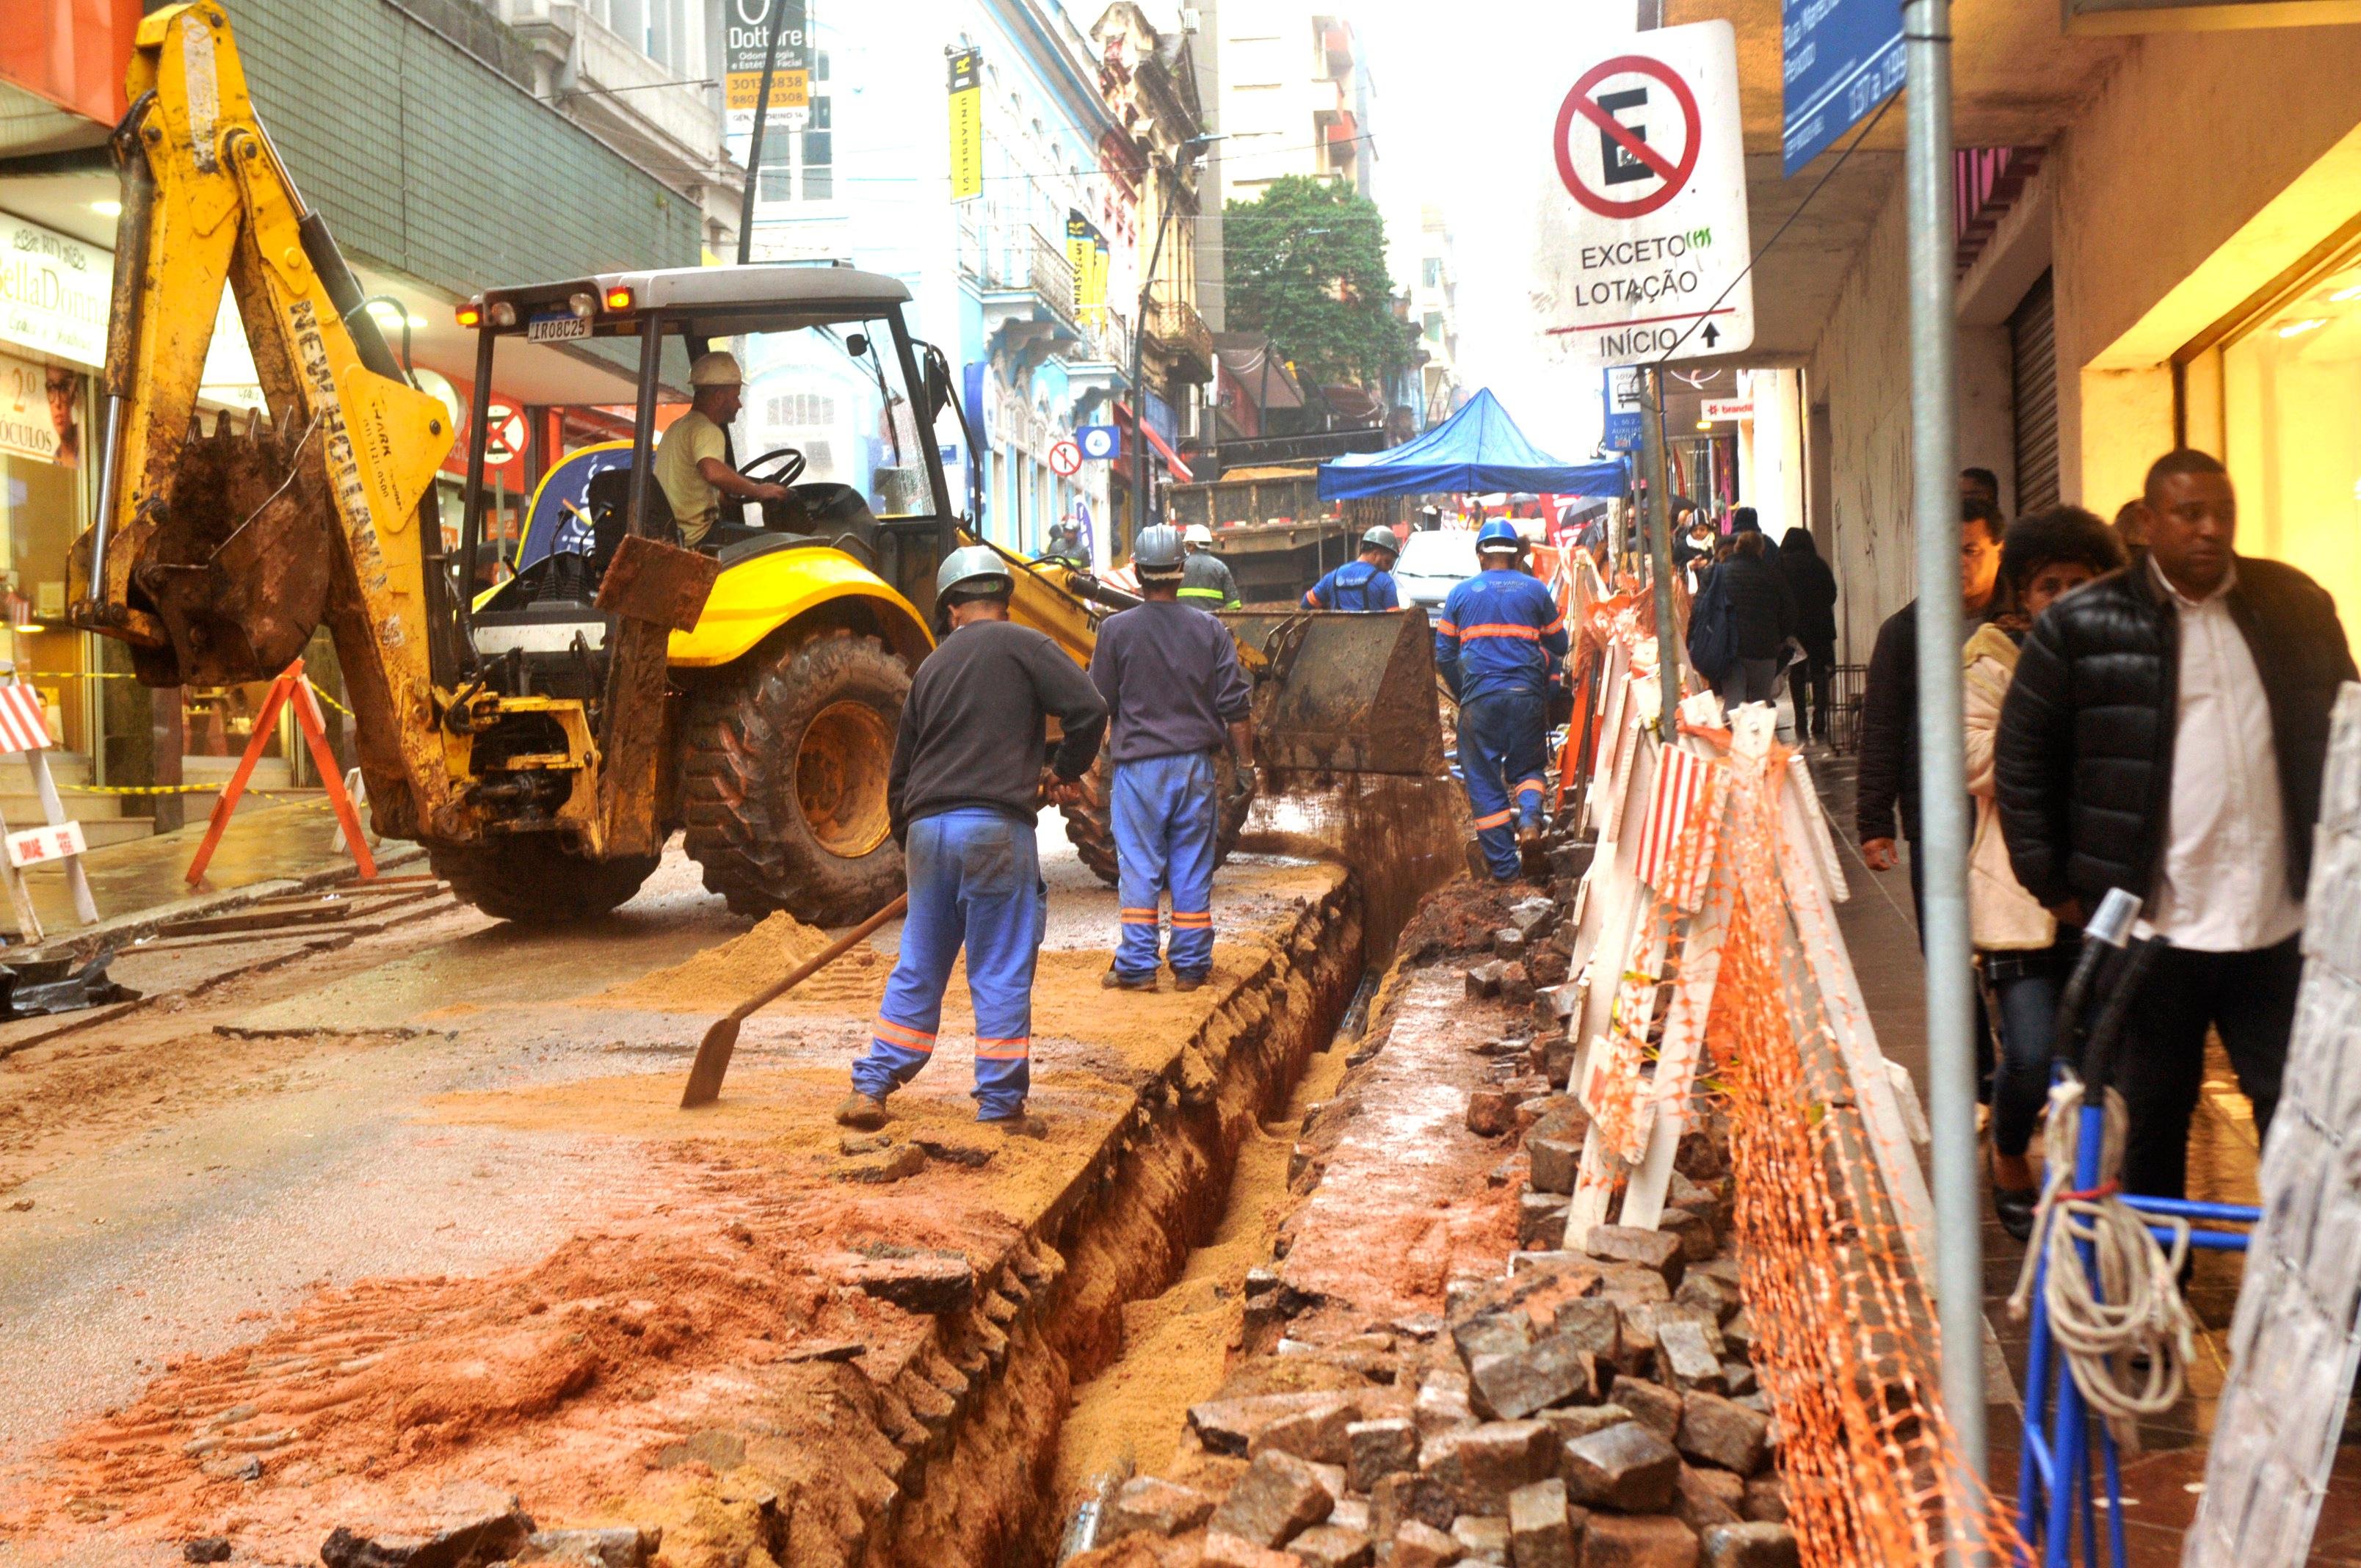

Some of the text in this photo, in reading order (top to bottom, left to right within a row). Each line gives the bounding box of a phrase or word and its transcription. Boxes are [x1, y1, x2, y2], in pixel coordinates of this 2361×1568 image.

[730, 26, 802, 48] Dottre
[739, 51, 795, 60] Odontogia
[961, 97, 970, 192] UNIASSELVI
[1581, 234, 1686, 269] EXCETO
[1575, 269, 1697, 306] LOTAÇÃO
[289, 300, 335, 393] NEW
[1600, 328, 1678, 357] INÍCIO
[0, 414, 52, 452] ÓCULOS
